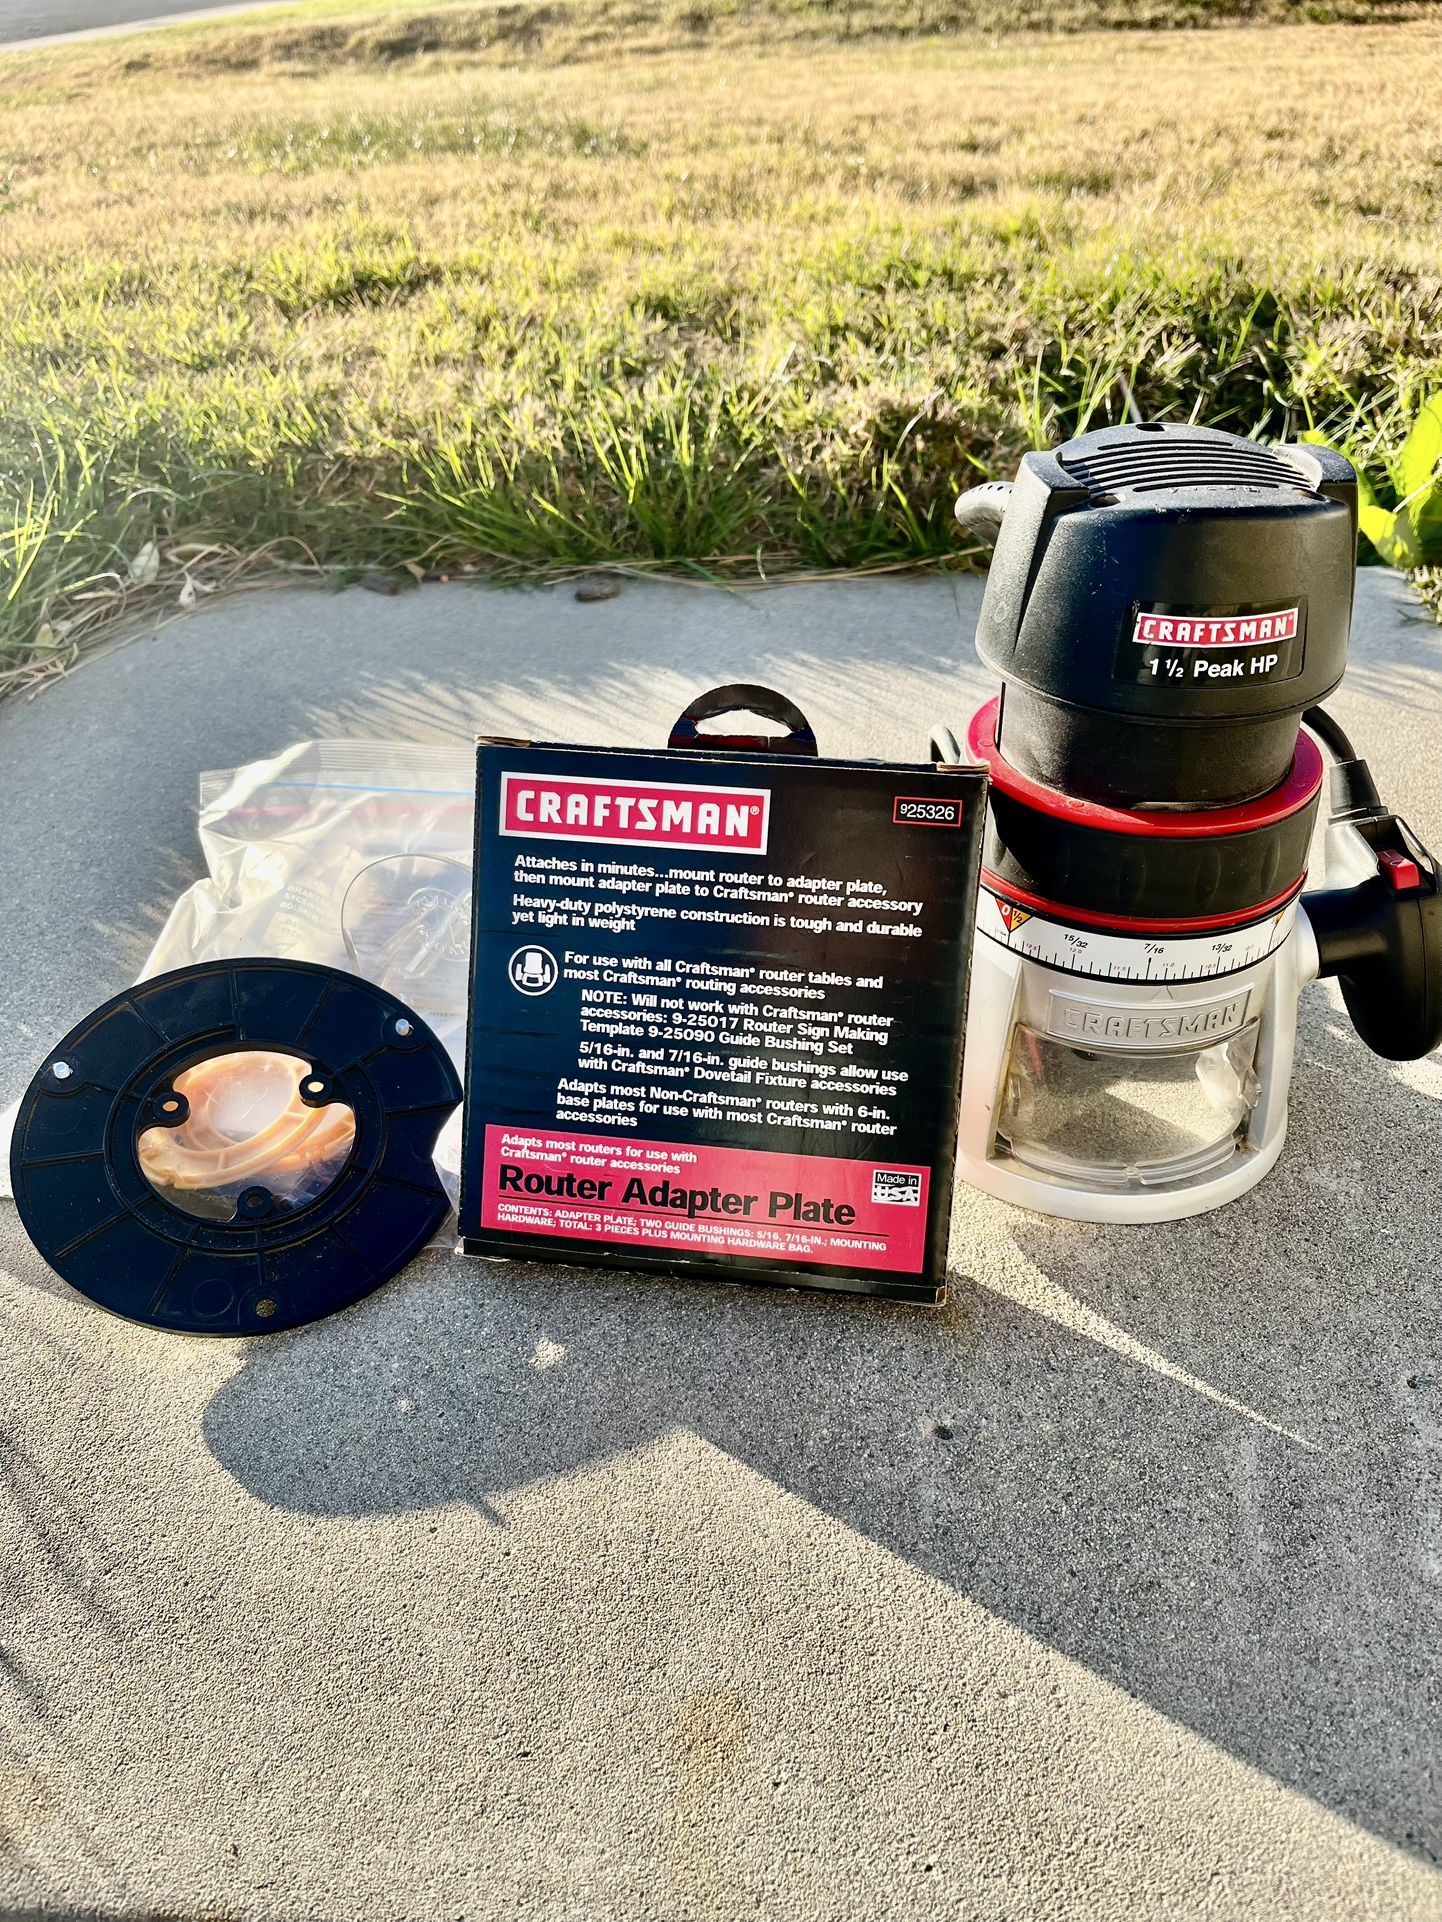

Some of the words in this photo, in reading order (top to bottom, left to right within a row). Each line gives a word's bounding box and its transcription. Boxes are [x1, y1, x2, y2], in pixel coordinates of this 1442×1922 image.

[1149, 658, 1159, 675] 1
[1193, 659, 1245, 678] Peak
[1250, 654, 1278, 675] HP
[900, 803, 955, 820] 925326
[514, 854, 577, 871] Attaches
[580, 858, 594, 872] in
[718, 872, 764, 885] router
[767, 874, 782, 886] to
[786, 875, 843, 892] adapter
[513, 869, 545, 884] then
[548, 874, 594, 887] mount
[597, 876, 652, 893] adapter
[655, 880, 690, 896] plate
[694, 884, 709, 896] to
[798, 893, 844, 906] router
[847, 897, 923, 914] accessory
[511, 911, 534, 924] yet
[537, 911, 568, 927] light
[571, 913, 584, 926] in
[588, 916, 635, 933] weight
[512, 893, 591, 915] Heavy-duty
[594, 901, 676, 919] polystyrene
[680, 909, 770, 926] construction
[773, 913, 786, 927] is
[789, 916, 832, 932] tough
[835, 920, 863, 932] and
[866, 920, 922, 937] durable
[1064, 933, 1088, 948] 15/32
[1144, 943, 1164, 954] 7/16
[1211, 942, 1233, 953] 13/32
[563, 968, 599, 980] most
[685, 978, 736, 995] routing
[739, 983, 825, 999] accessories
[564, 950, 589, 964] For
[592, 955, 618, 966] use
[621, 956, 652, 970] with
[655, 958, 672, 971] all
[759, 969, 805, 982] router
[807, 971, 852, 986] tables
[855, 976, 883, 988] and
[631, 993, 657, 1007] Will
[660, 998, 684, 1009] not
[687, 1000, 724, 1013] work
[727, 1002, 758, 1016] with
[847, 1014, 894, 1026] router
[1064, 1001, 1240, 1038] CRAFTSMAN
[580, 1018, 644, 1037] Template
[648, 1025, 715, 1042] 9-25090
[718, 1031, 760, 1046] Guide
[764, 1035, 823, 1055] Bushing
[827, 1040, 853, 1054] Set
[672, 1012, 738, 1029] 9-25017
[743, 1018, 794, 1034] Router
[796, 1022, 829, 1039] Sign
[833, 1025, 888, 1045] Making
[577, 1056, 607, 1070] with
[693, 1066, 751, 1083] Dovetail
[755, 1071, 807, 1088] Fixture
[810, 1079, 896, 1096] accessories
[638, 1048, 664, 1060] and
[728, 1055, 768, 1070] guide
[771, 1057, 836, 1078] bushings
[839, 1064, 878, 1079] allow
[881, 1070, 908, 1081] use
[557, 1077, 606, 1095] Adapts
[610, 1085, 646, 1097] most
[765, 1099, 818, 1113] routers
[822, 1102, 853, 1116] with
[555, 1109, 637, 1126] accessories
[556, 1092, 589, 1107] base
[592, 1096, 635, 1111] plates
[638, 1100, 660, 1113] for
[662, 1105, 688, 1116] use
[692, 1105, 722, 1119] with
[726, 1111, 763, 1123] most
[851, 1122, 897, 1135] router
[501, 1134, 542, 1150] Adapts
[545, 1140, 576, 1150] most
[578, 1143, 622, 1155] routers
[625, 1145, 643, 1157] for
[646, 1150, 668, 1160] use
[671, 1151, 697, 1163] with
[570, 1155, 607, 1166] router
[609, 1159, 680, 1174] accessories
[499, 1164, 612, 1200] Router
[620, 1177, 758, 1218] Adapter
[768, 1191, 855, 1226] Plate
[875, 1185, 916, 1202] USA
[877, 1173, 905, 1184] Made
[907, 1175, 917, 1185] in
[554, 1209, 601, 1221] ADAPTER
[639, 1218, 662, 1228] TWO
[664, 1221, 695, 1231] GUIDE
[830, 1237, 886, 1250] MOUNTING
[595, 1223, 601, 1231] 3
[604, 1224, 639, 1235] PIECES
[641, 1228, 668, 1238] PLUS
[670, 1231, 725, 1244] MOUNTING
[727, 1236, 786, 1250] HARDWARE
